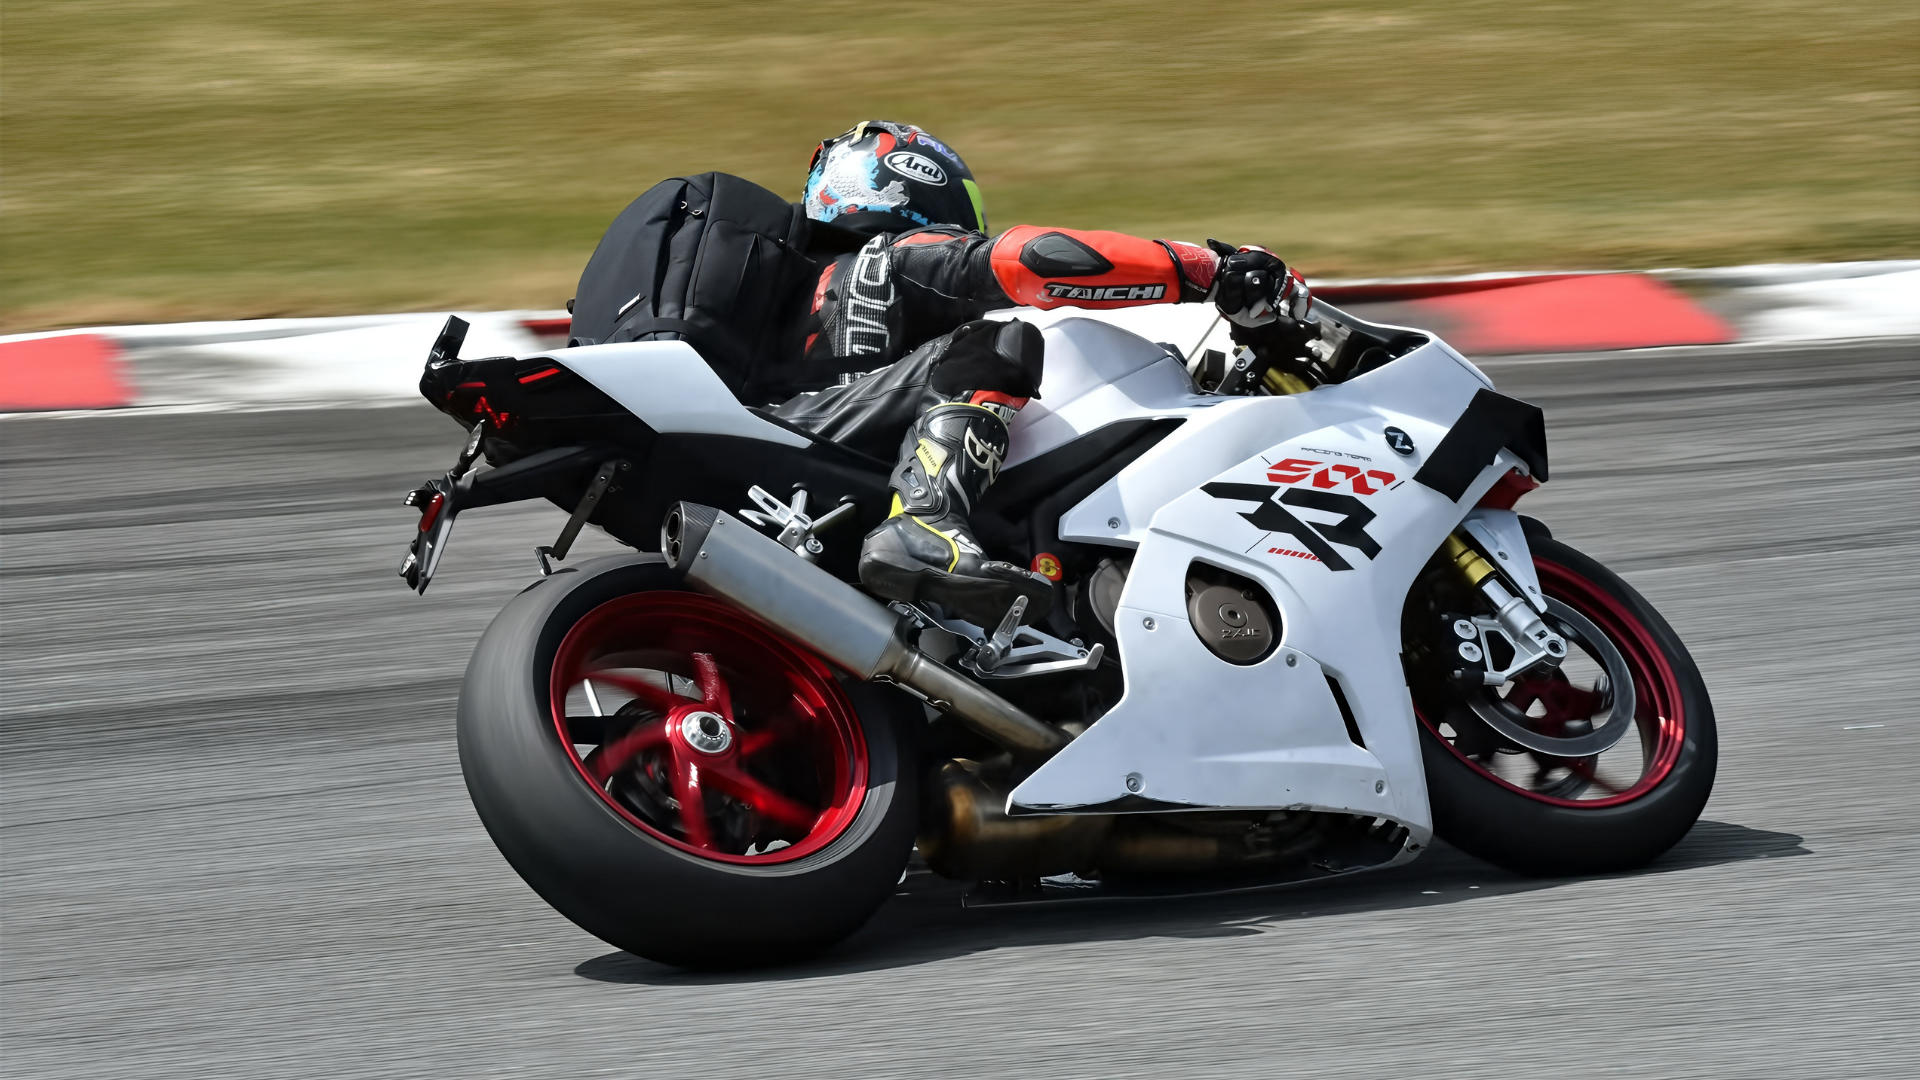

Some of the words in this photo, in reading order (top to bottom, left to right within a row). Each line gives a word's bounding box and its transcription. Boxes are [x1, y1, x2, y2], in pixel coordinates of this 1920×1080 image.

[891, 156, 941, 179] Arai
[1047, 284, 1165, 300] TAICHI
[1301, 447, 1343, 457] RACING
[1344, 452, 1372, 462] TEAM
[1266, 458, 1397, 496] 500
